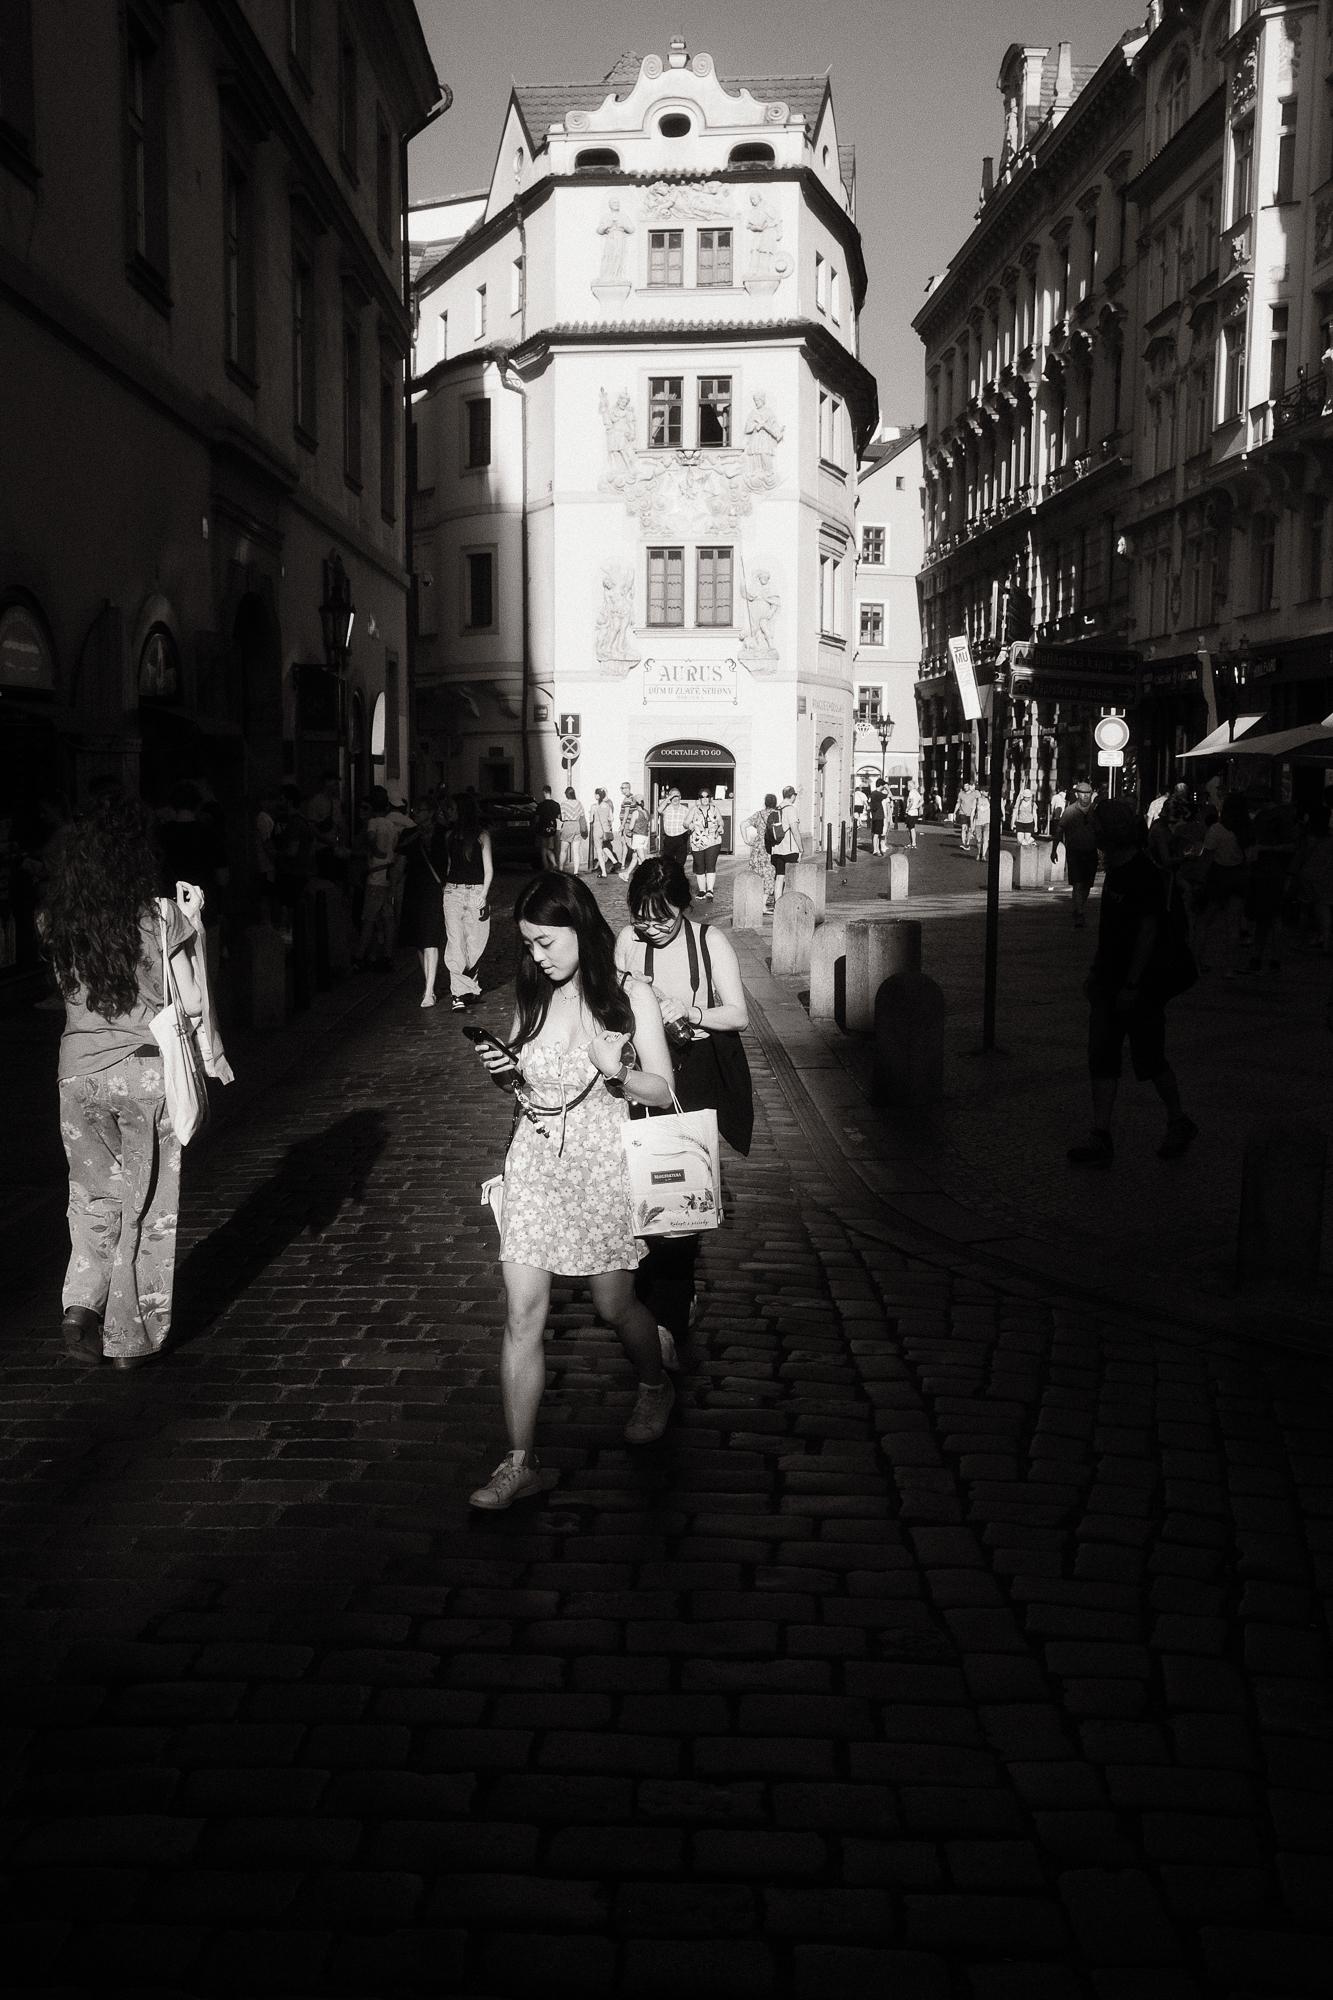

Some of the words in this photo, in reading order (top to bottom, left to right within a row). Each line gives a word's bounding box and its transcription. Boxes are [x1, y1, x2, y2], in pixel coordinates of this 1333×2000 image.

[659, 665, 723, 682] AURUS
[660, 749, 699, 757] COCKTAILS
[700, 749, 710, 757] TO
[711, 749, 722, 757] GO
